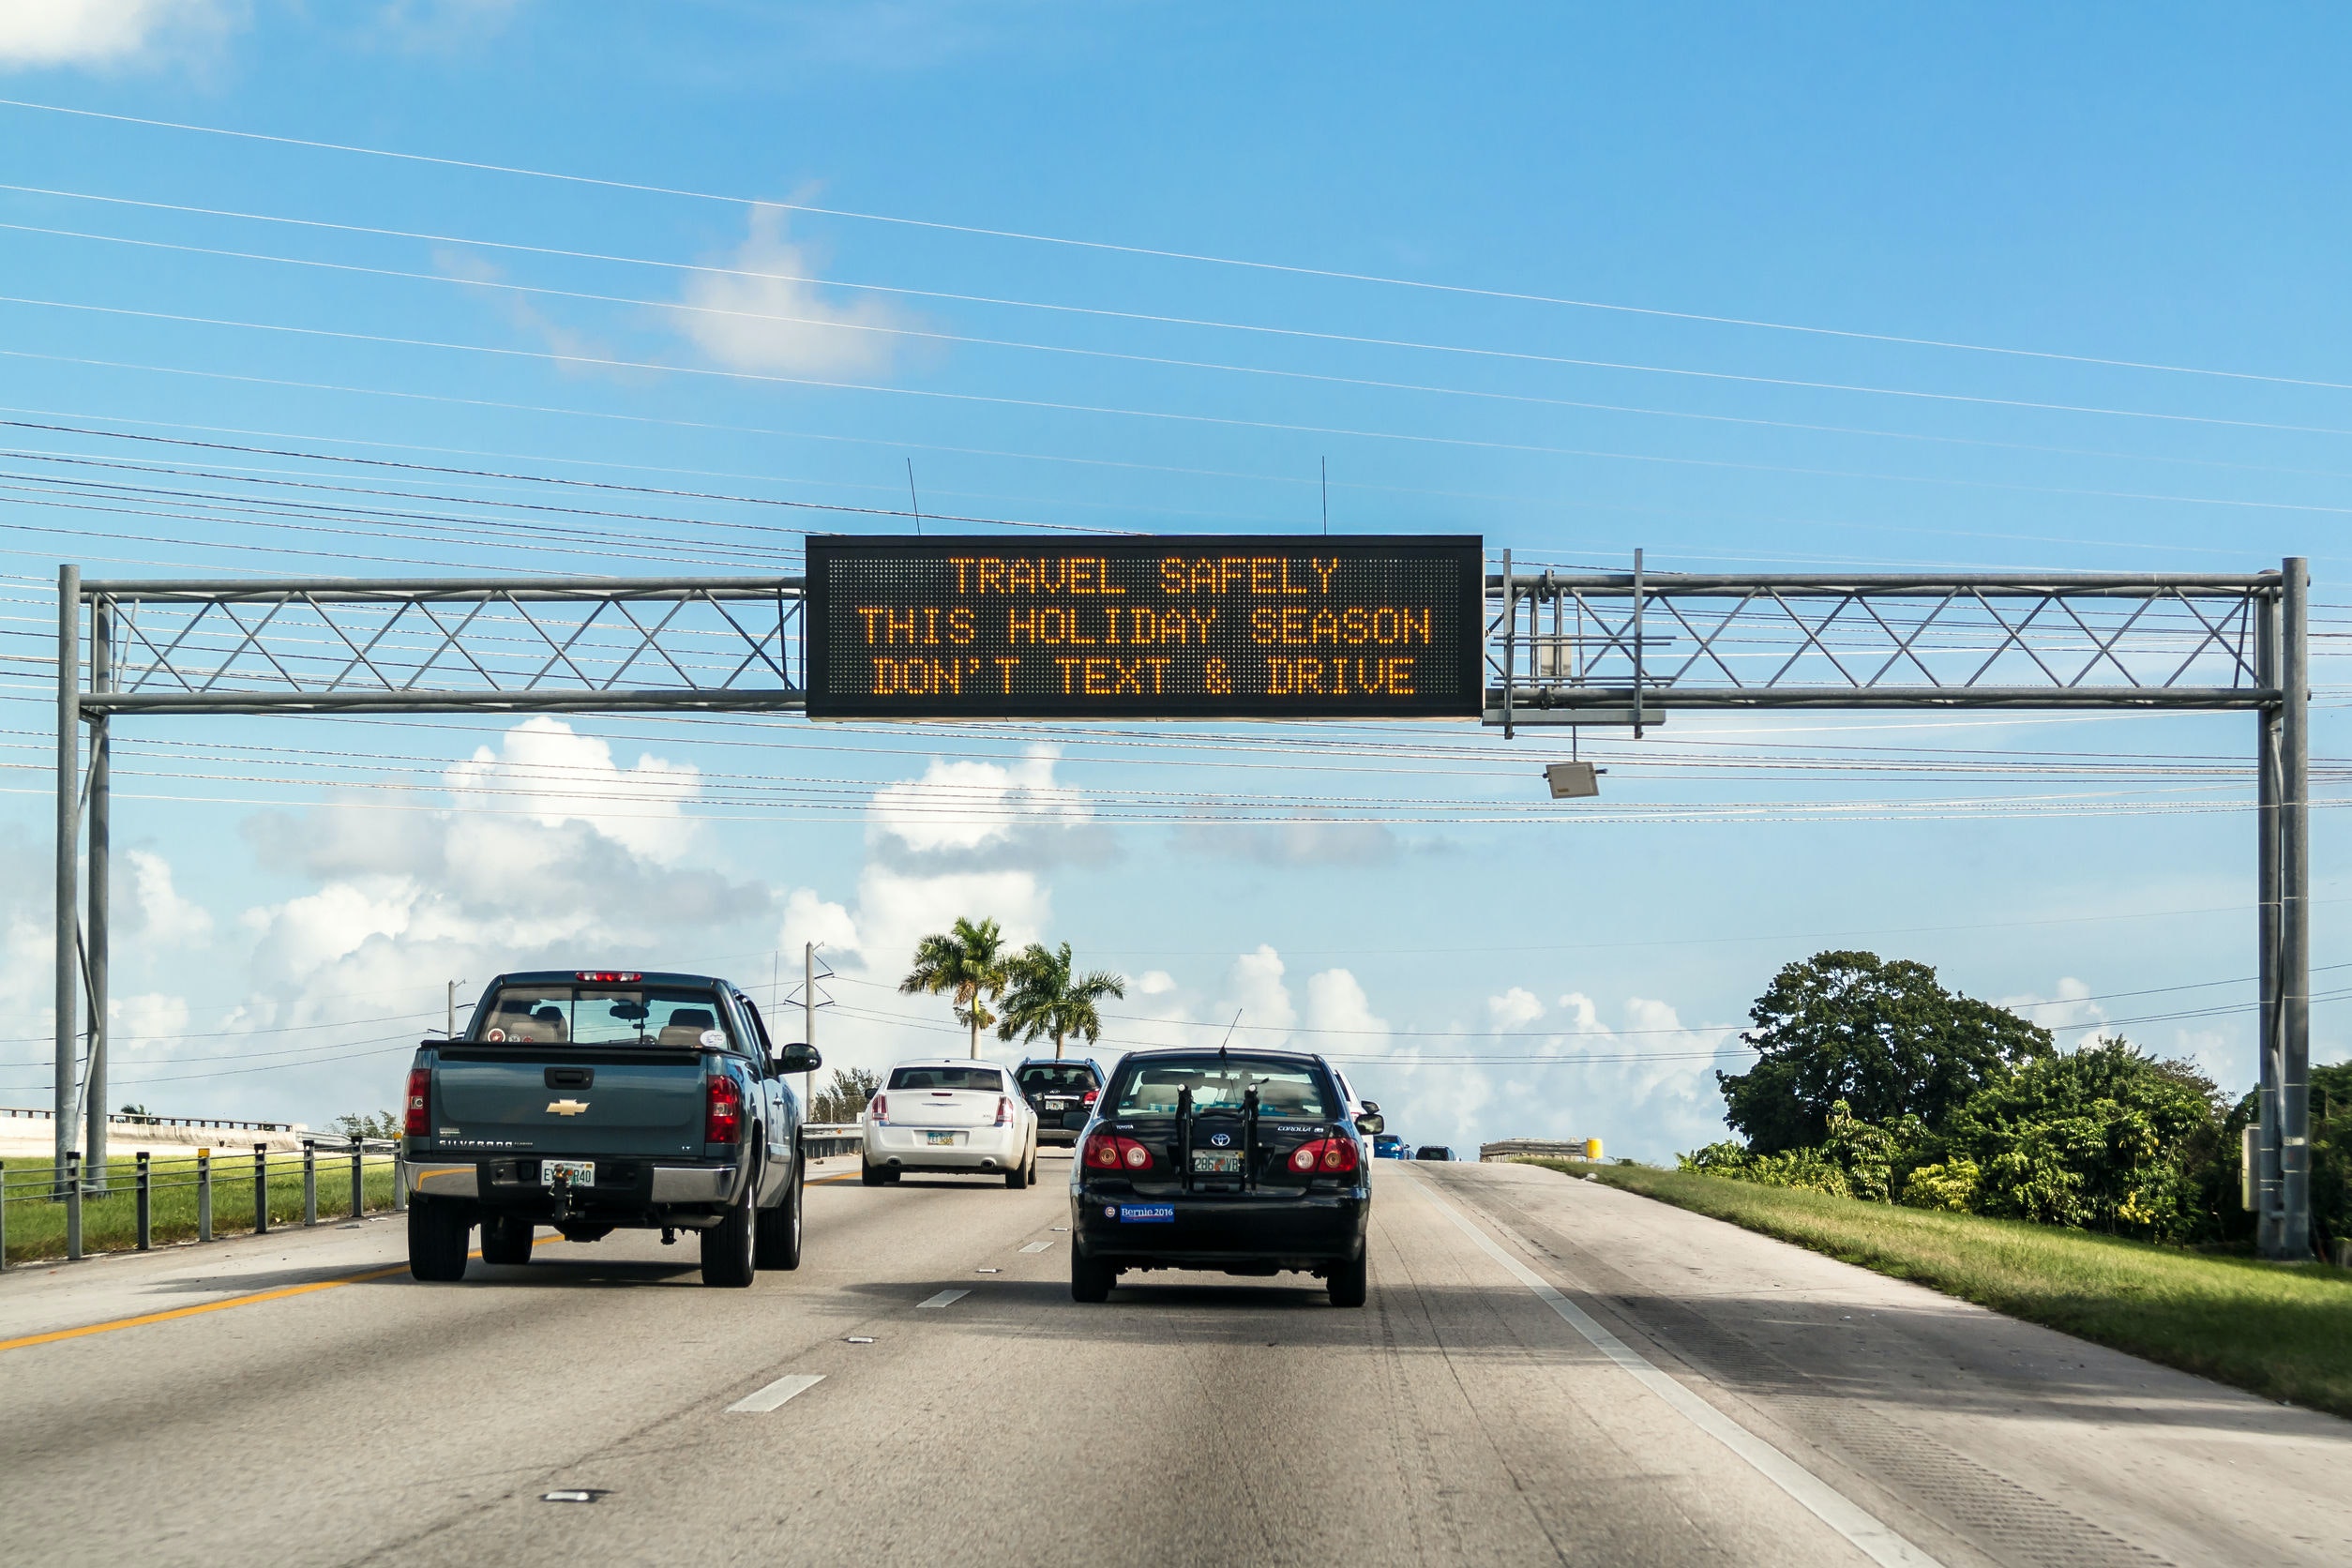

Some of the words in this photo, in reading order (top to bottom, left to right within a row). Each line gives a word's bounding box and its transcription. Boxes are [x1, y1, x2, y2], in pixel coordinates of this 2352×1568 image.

[949, 558, 1126, 594] TRAVEL
[1160, 557, 1338, 594] SAFELY
[858, 608, 975, 644] THIS
[1009, 608, 1216, 644] HOLIDAY
[1251, 608, 1429, 644] SEASON
[873, 657, 1020, 695] DON'T
[1055, 658, 1171, 695] TEXT
[1206, 658, 1231, 694] &
[1267, 657, 1414, 695] DRIVE
[1122, 1207, 1153, 1216] Bernie
[1153, 1208, 1174, 1216] 2016
